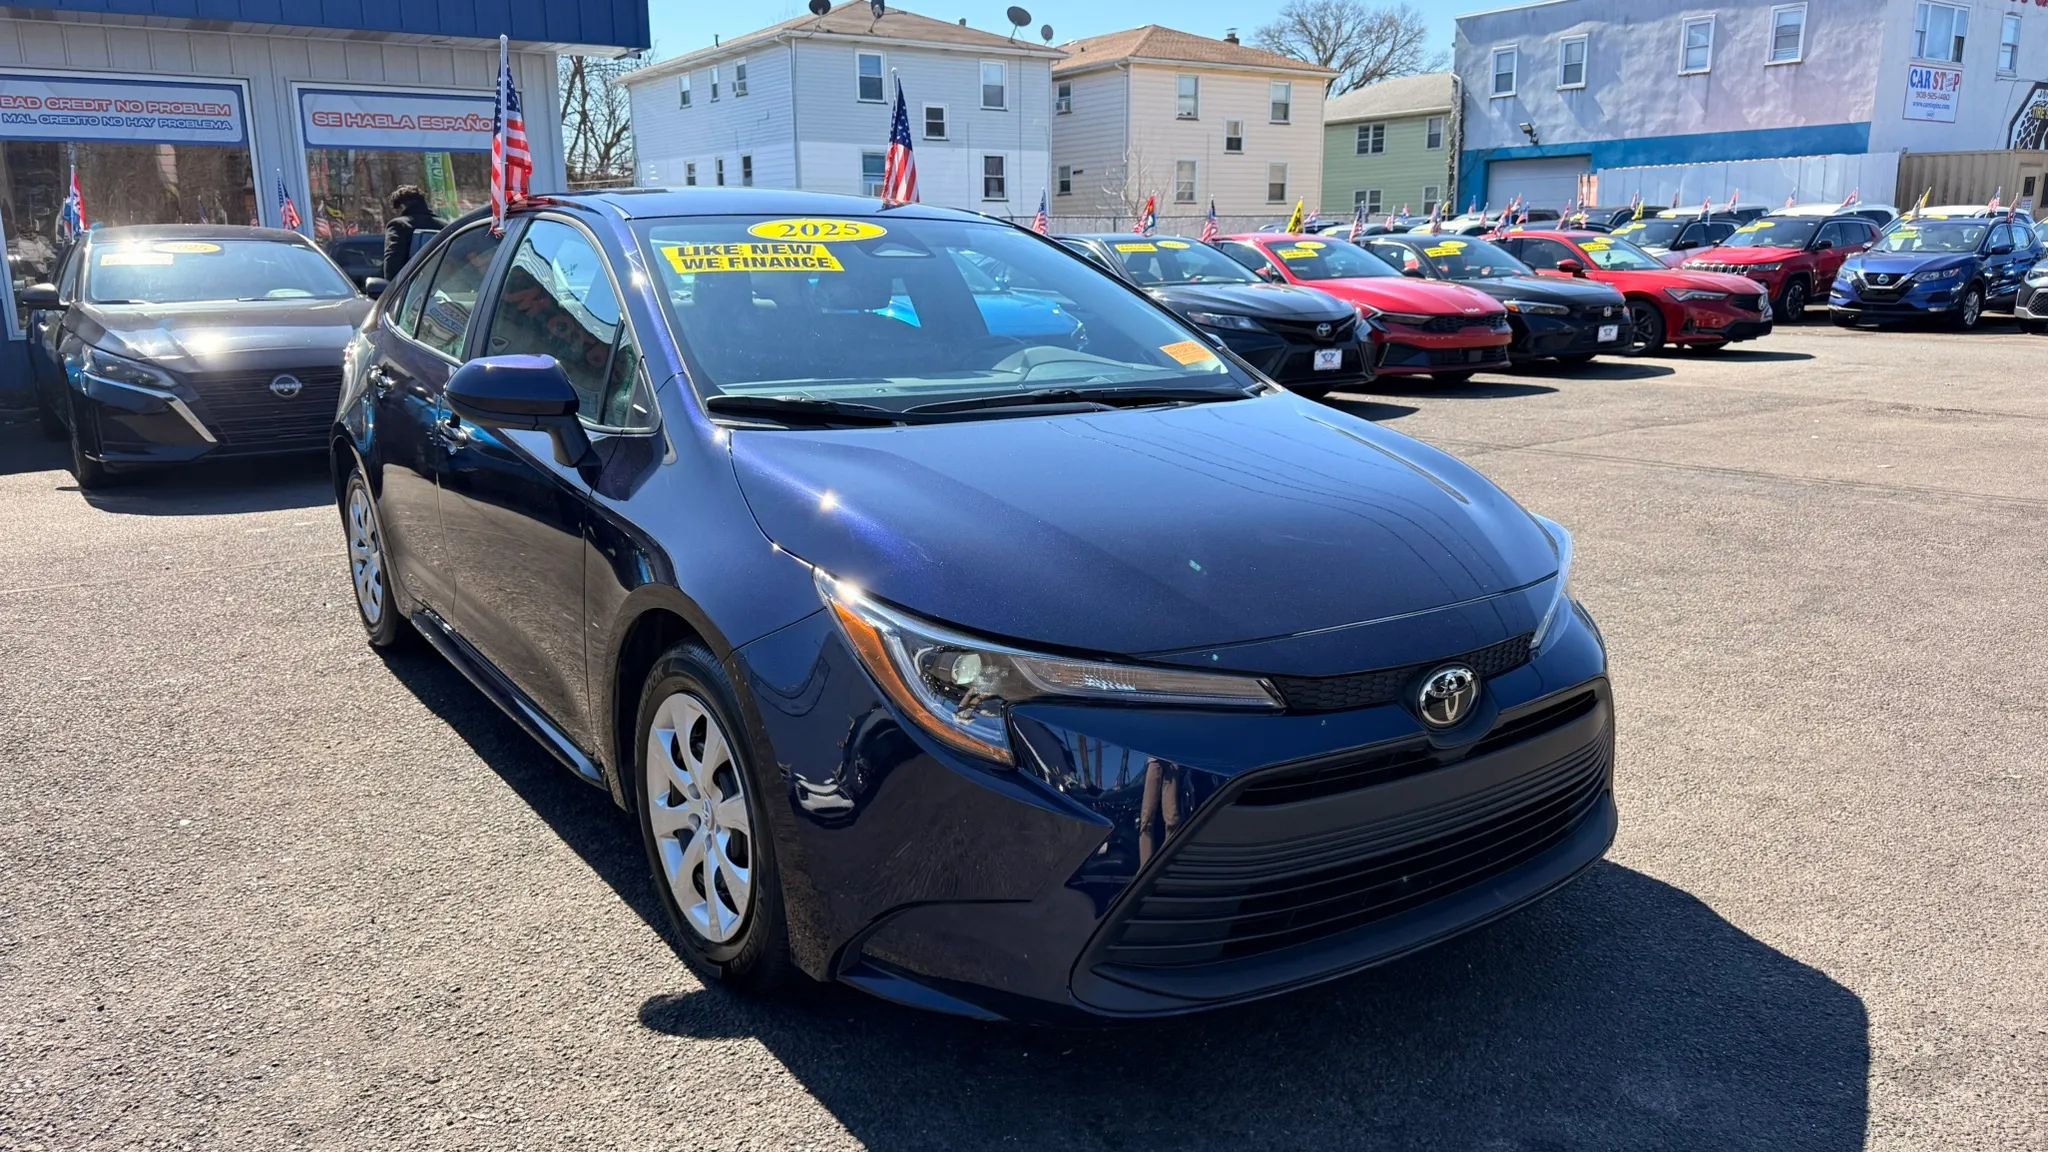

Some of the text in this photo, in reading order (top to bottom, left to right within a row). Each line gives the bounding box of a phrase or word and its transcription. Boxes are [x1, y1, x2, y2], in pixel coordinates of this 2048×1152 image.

[1910, 69, 1960, 92] CAR STOP
[0, 96, 232, 116] BAD CREDIT NO PROBLEM
[1, 113, 232, 130] MAL CREDITO NO HAY PROBLEMA
[312, 111, 495, 132] SE HABLA ESPAÑO
[779, 223, 861, 238] 2025
[677, 243, 816, 257] LIKE NEW
[680, 256, 833, 270] WE FINANCE
